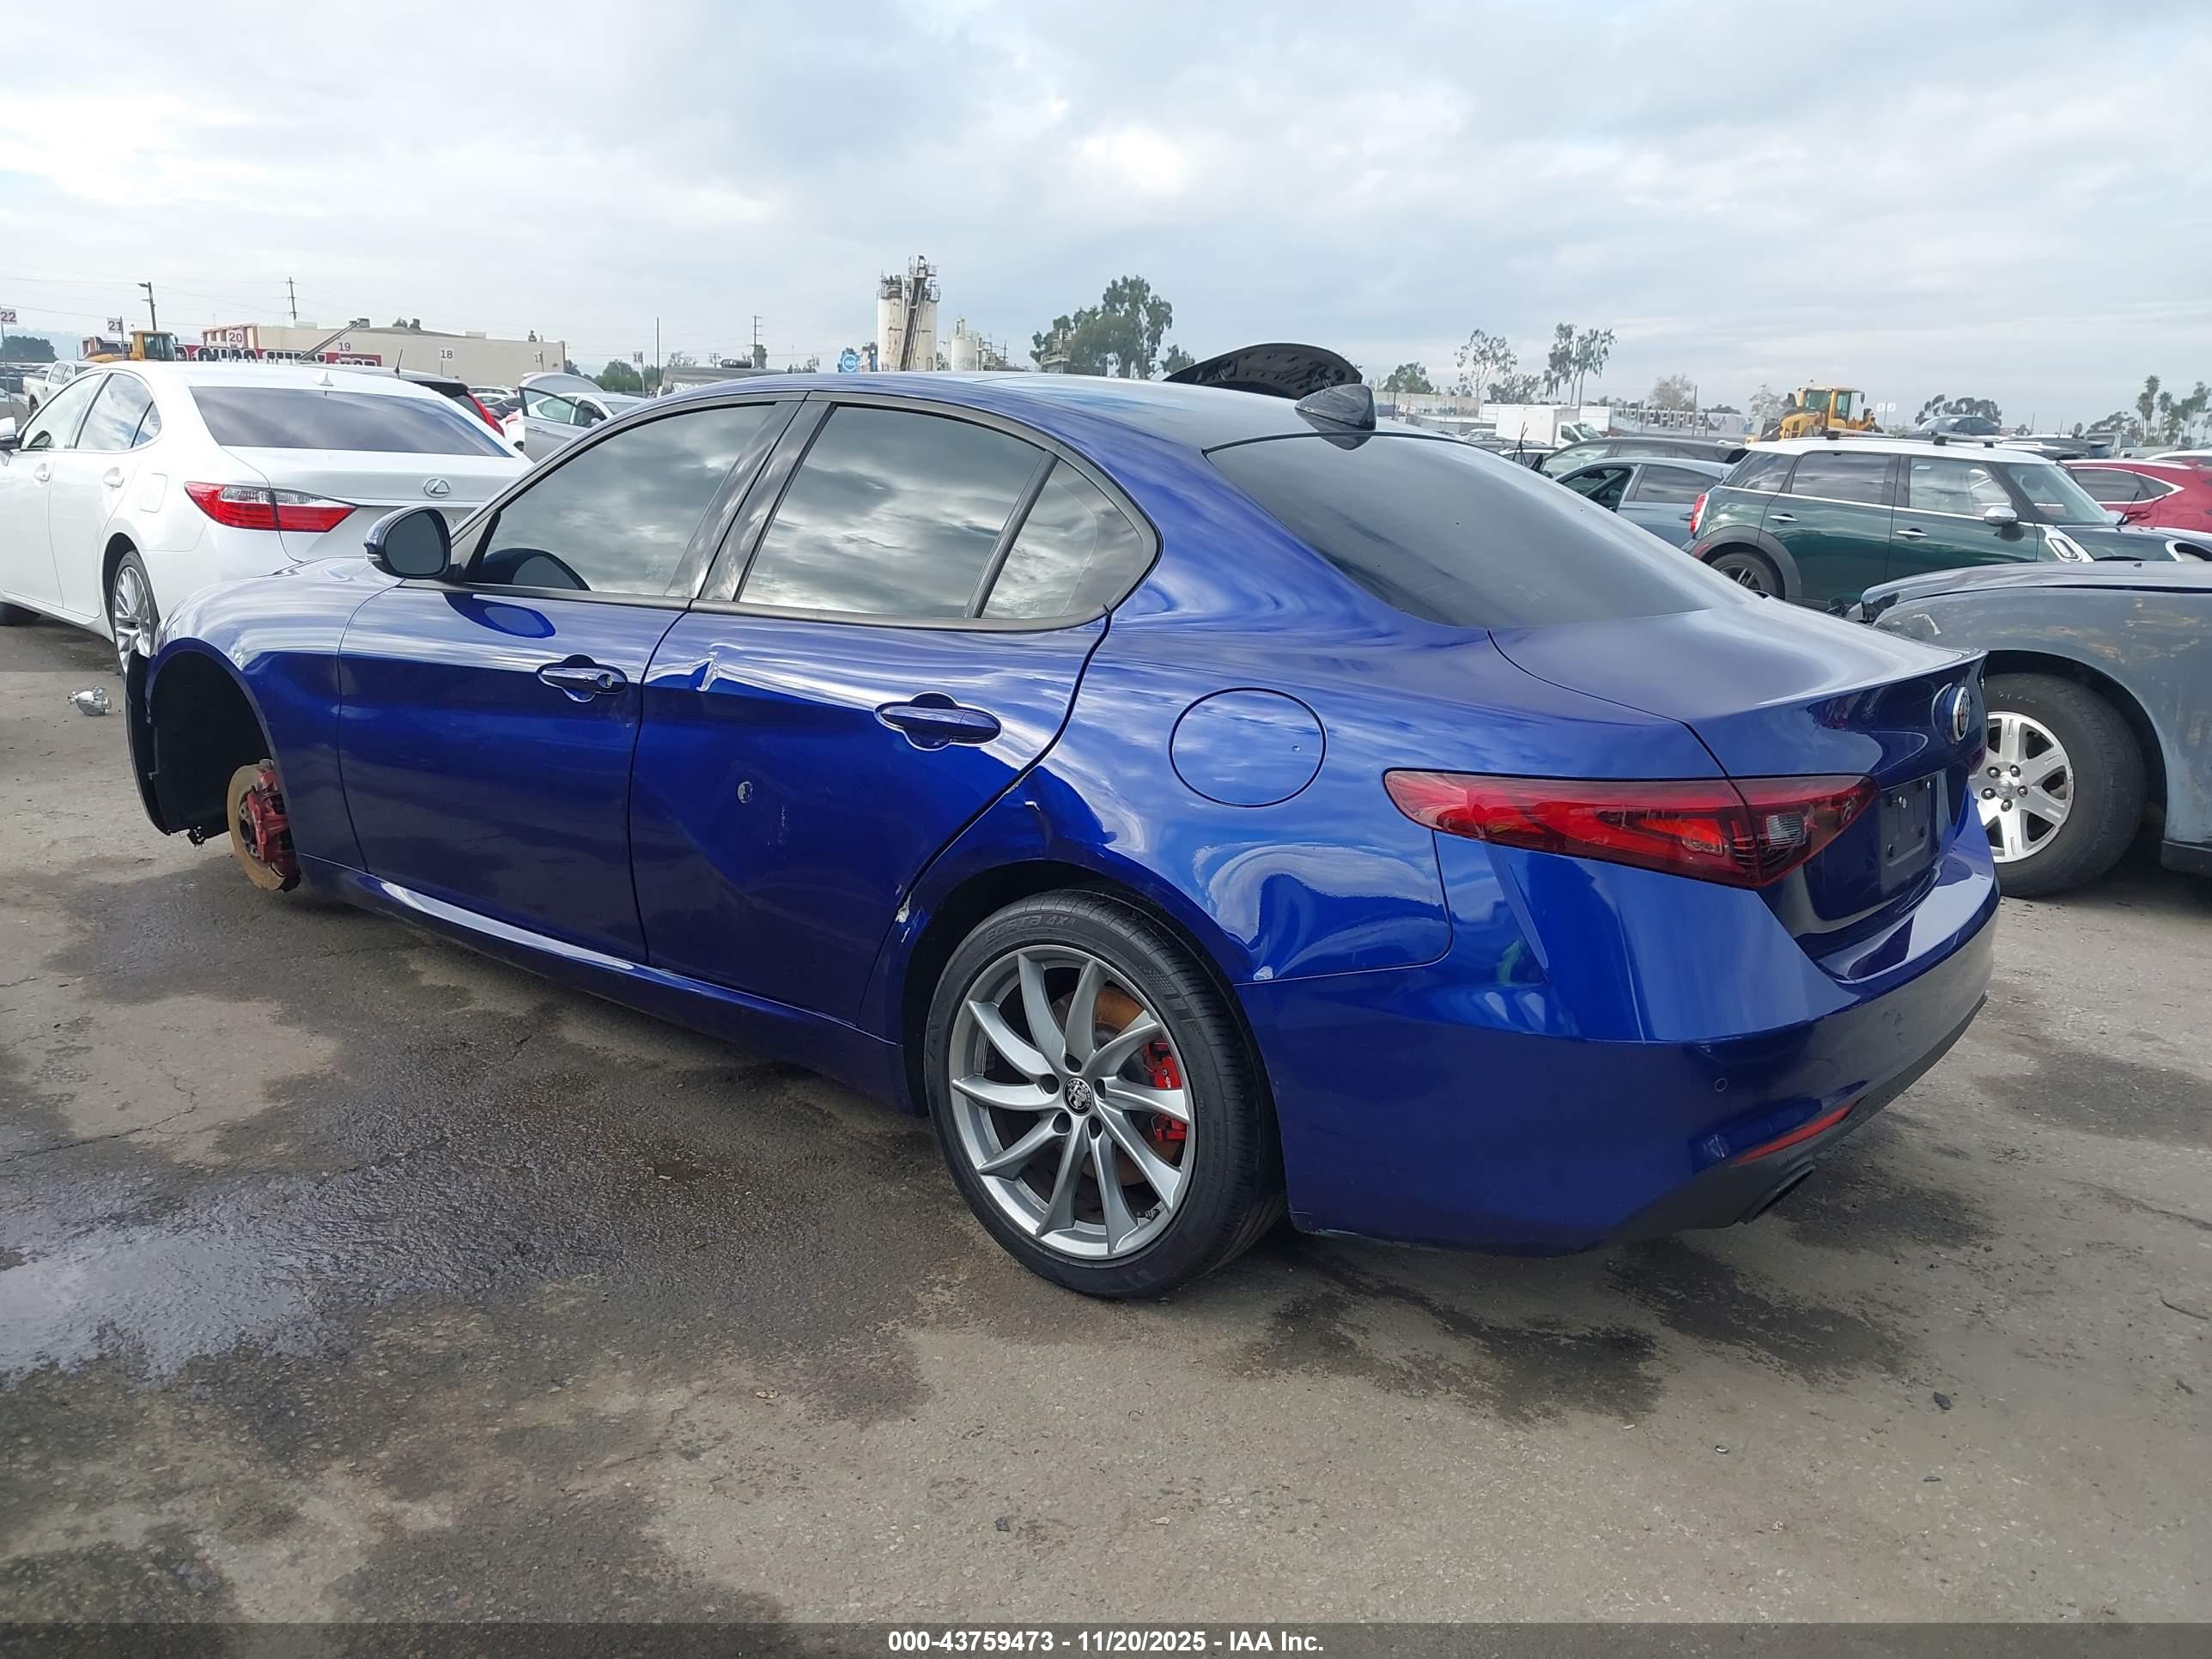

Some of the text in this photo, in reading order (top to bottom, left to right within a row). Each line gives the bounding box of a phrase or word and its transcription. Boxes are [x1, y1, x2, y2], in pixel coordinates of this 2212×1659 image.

[0, 311, 17, 323] 22
[108, 320, 122, 331] 21
[228, 331, 243, 343] 20
[338, 342, 351, 351] 19
[440, 349, 453, 359] 18
